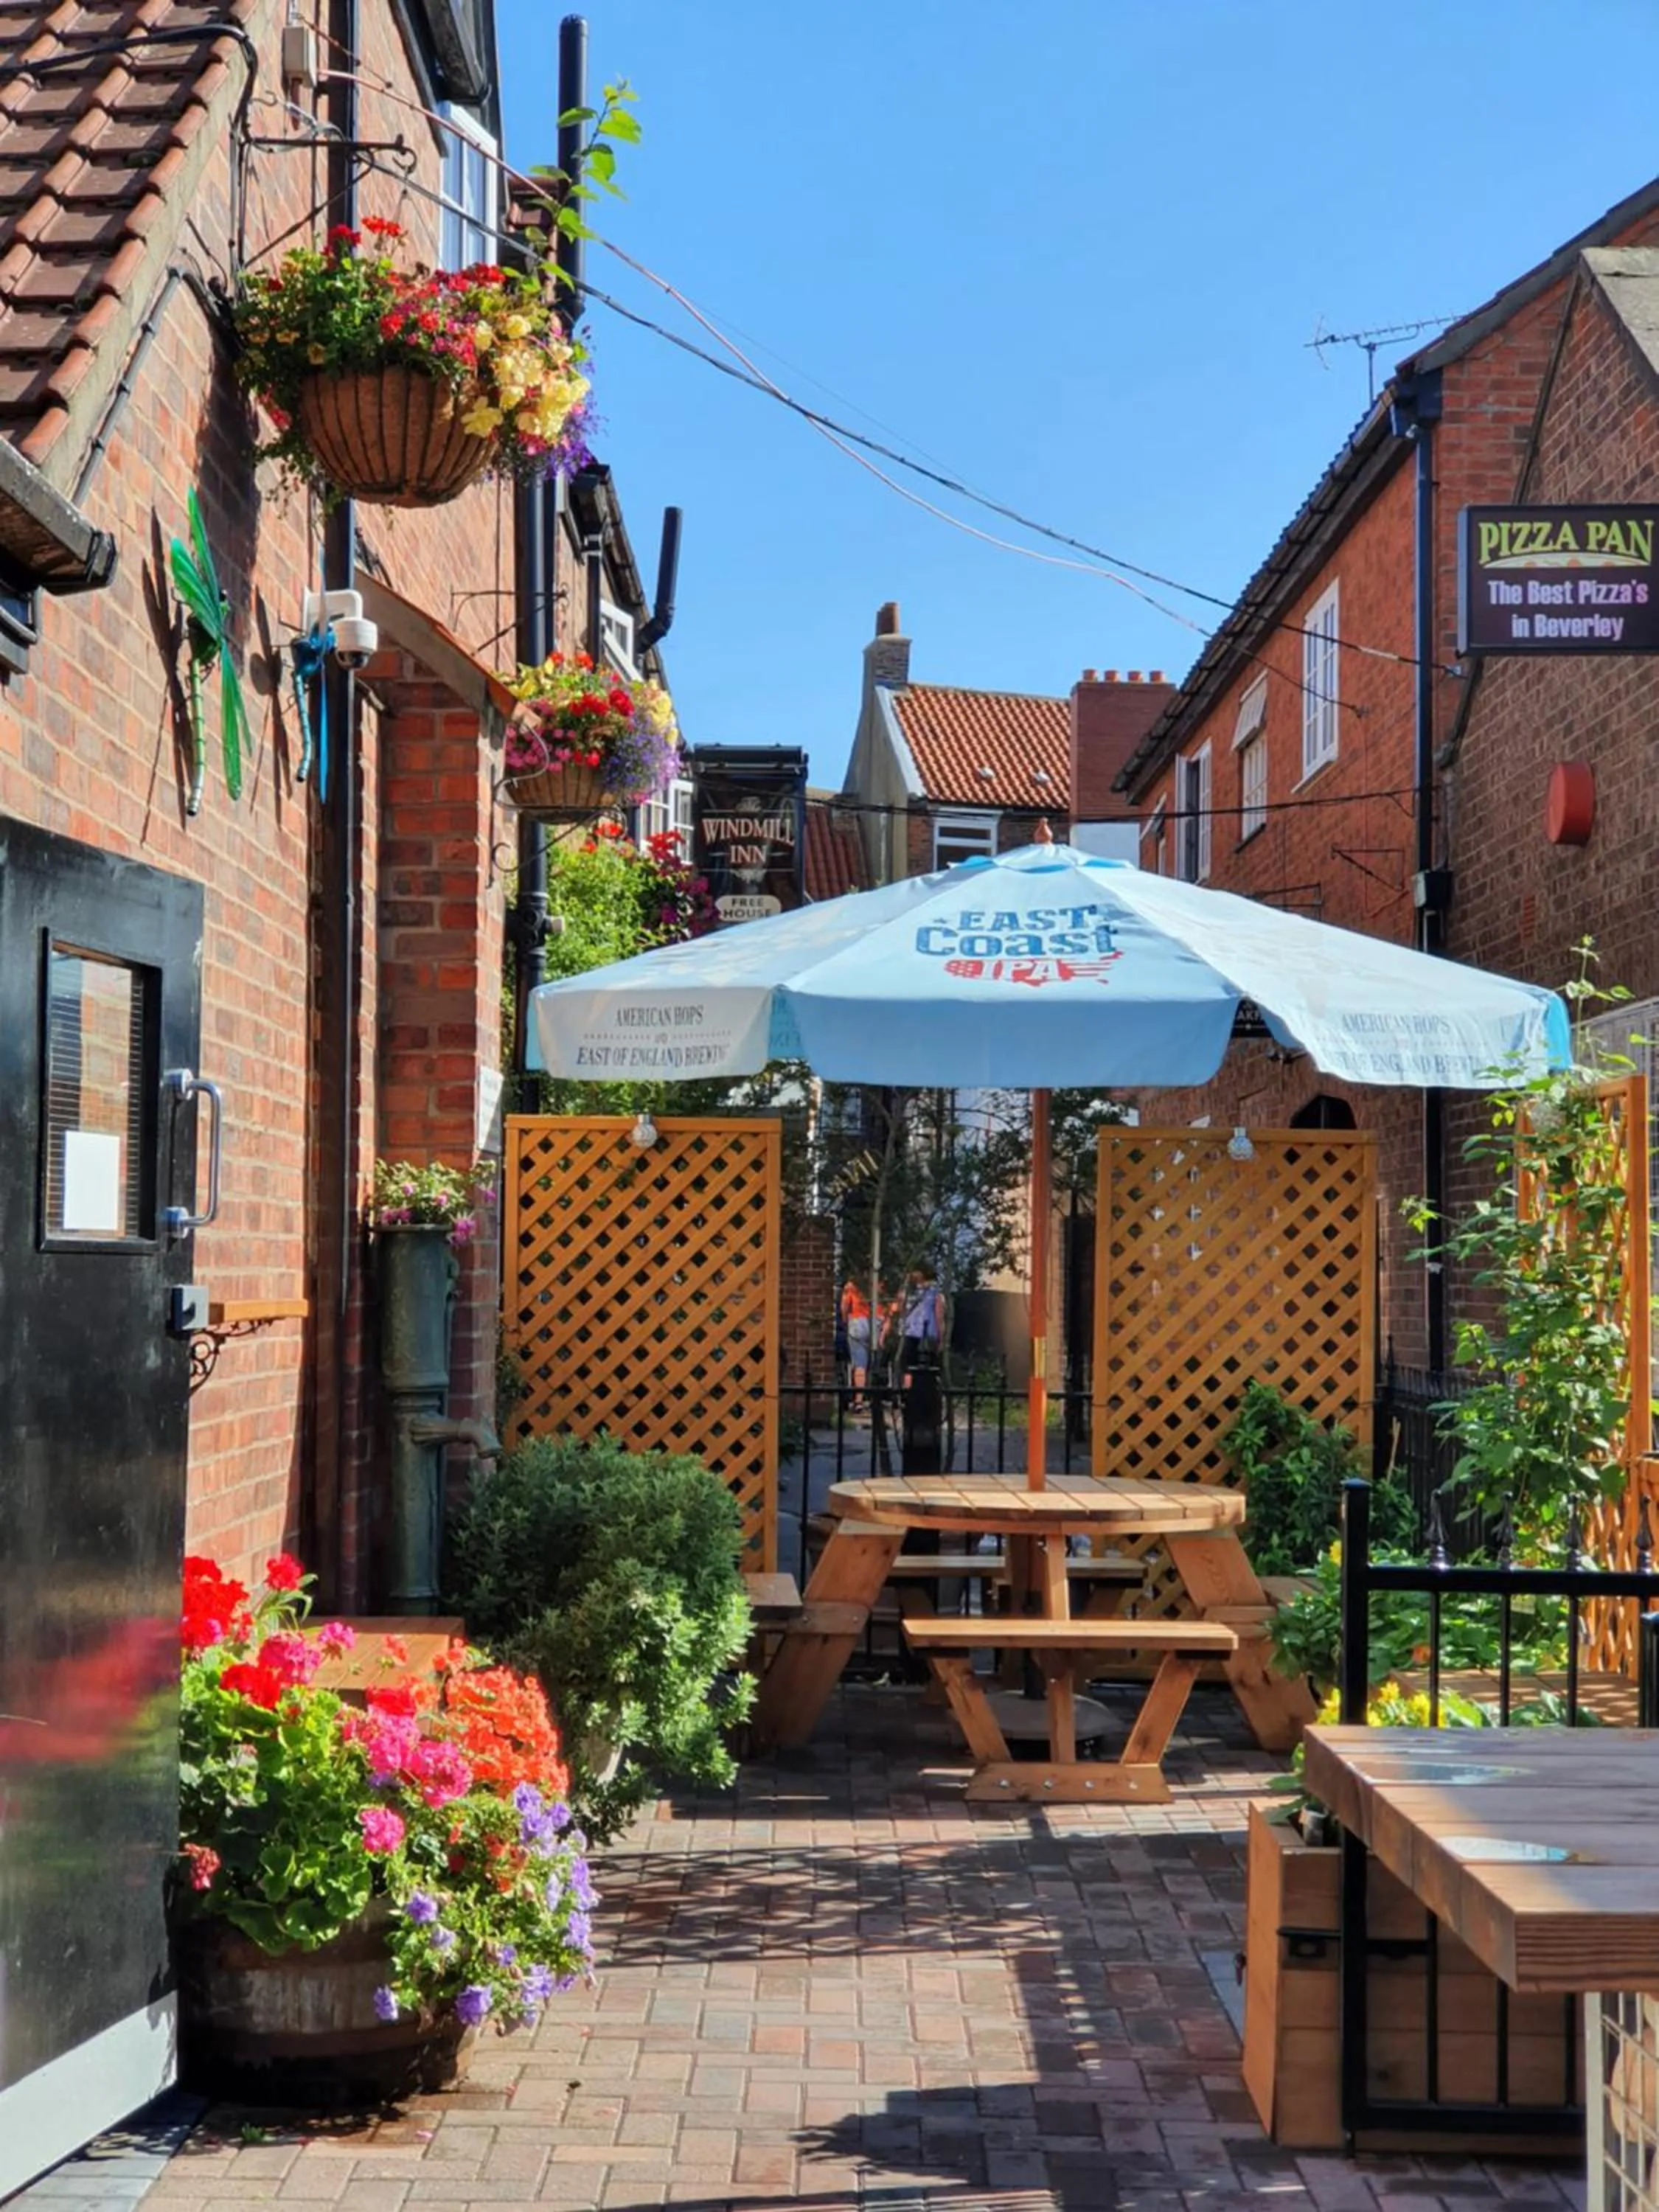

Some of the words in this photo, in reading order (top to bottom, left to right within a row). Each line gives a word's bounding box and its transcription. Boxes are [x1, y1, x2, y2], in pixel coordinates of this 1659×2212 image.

[1478, 521, 1580, 565] PIZZA
[1586, 520, 1655, 565] PAN
[1488, 580, 1523, 605] The
[1527, 580, 1574, 605] Best
[1578, 579, 1649, 605] Pizza's
[1512, 613, 1529, 638] in
[1534, 613, 1624, 641] Beverley
[702, 817, 796, 847] WINDMILL
[730, 844, 768, 864] INN
[723, 908, 773, 919] HOUSE
[731, 897, 765, 908] FREE
[958, 903, 1099, 932] EAST
[915, 924, 1119, 957] Coast
[980, 958, 1062, 981] IPA
[615, 1006, 672, 1027] AMERICAN
[674, 1004, 706, 1026] HOPS
[1342, 1013, 1412, 1034] AMERICAN
[1413, 1013, 1451, 1034] HOPS
[576, 1045, 611, 1066] EAST
[613, 1046, 628, 1066] OF
[628, 1046, 684, 1068] ENGLAND
